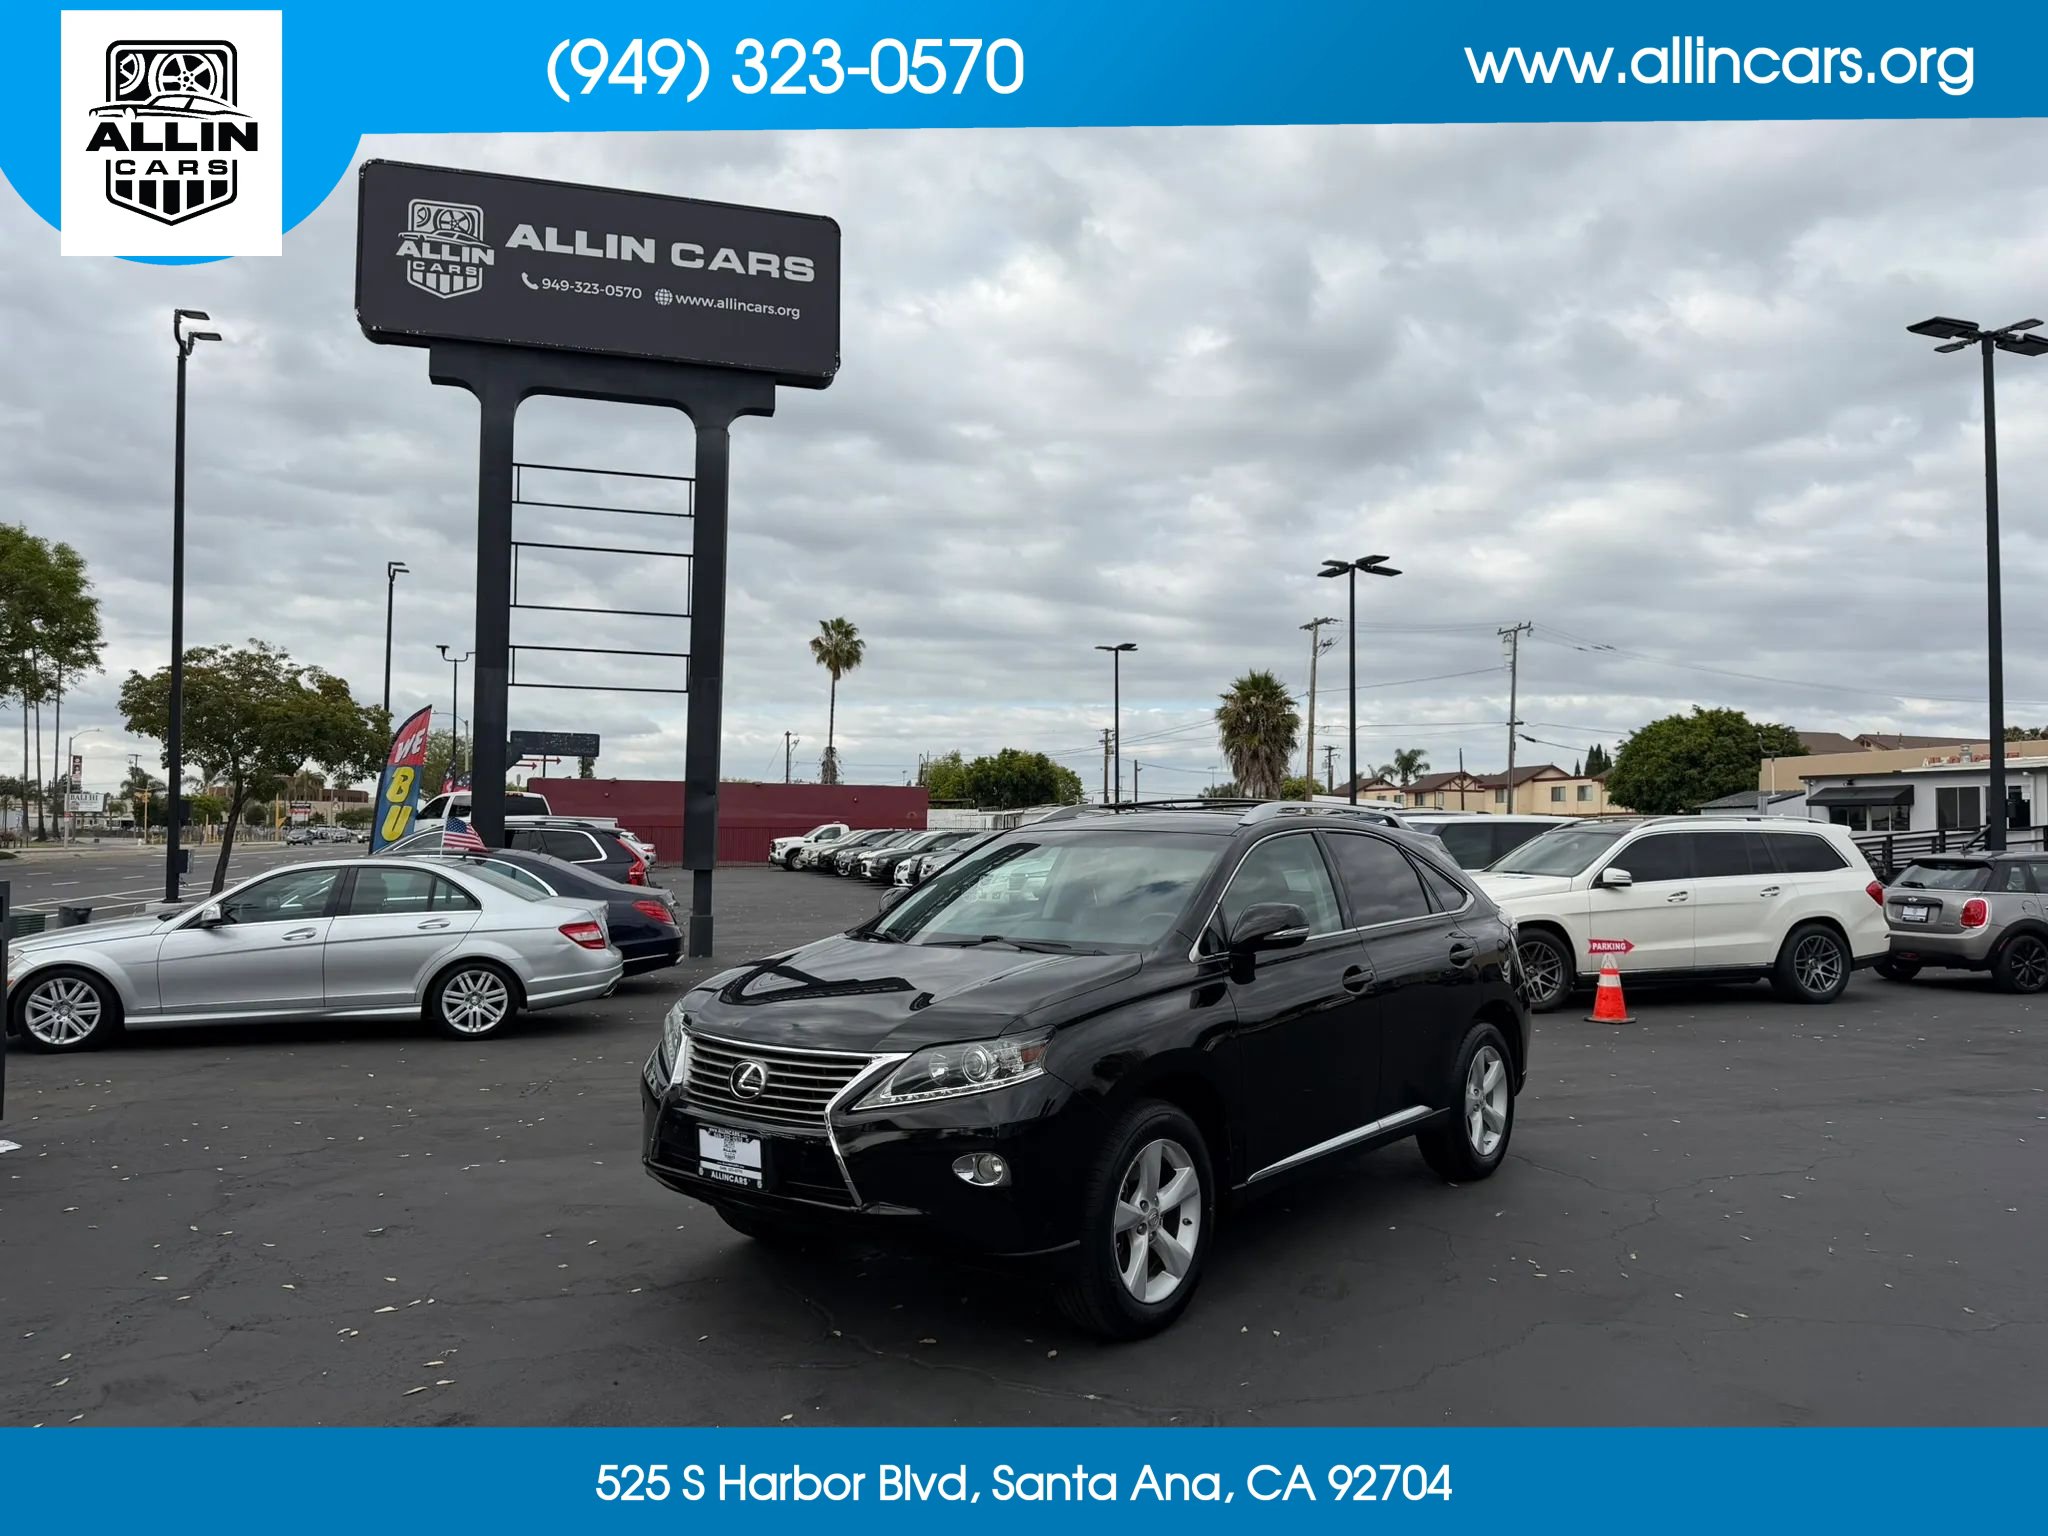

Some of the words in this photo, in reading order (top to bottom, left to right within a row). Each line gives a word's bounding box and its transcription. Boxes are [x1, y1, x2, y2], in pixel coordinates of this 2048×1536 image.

[396, 240, 495, 266] ALLIN
[505, 223, 656, 264] ALLIN
[670, 242, 815, 282] CARS
[412, 261, 477, 276] CARS
[541, 277, 643, 300] 949-323-0570
[675, 293, 801, 320] www.allincars.org
[394, 728, 426, 763] WE
[1592, 942, 1626, 951] PARKING
[711, 1170, 748, 1185] ALLINCARS
